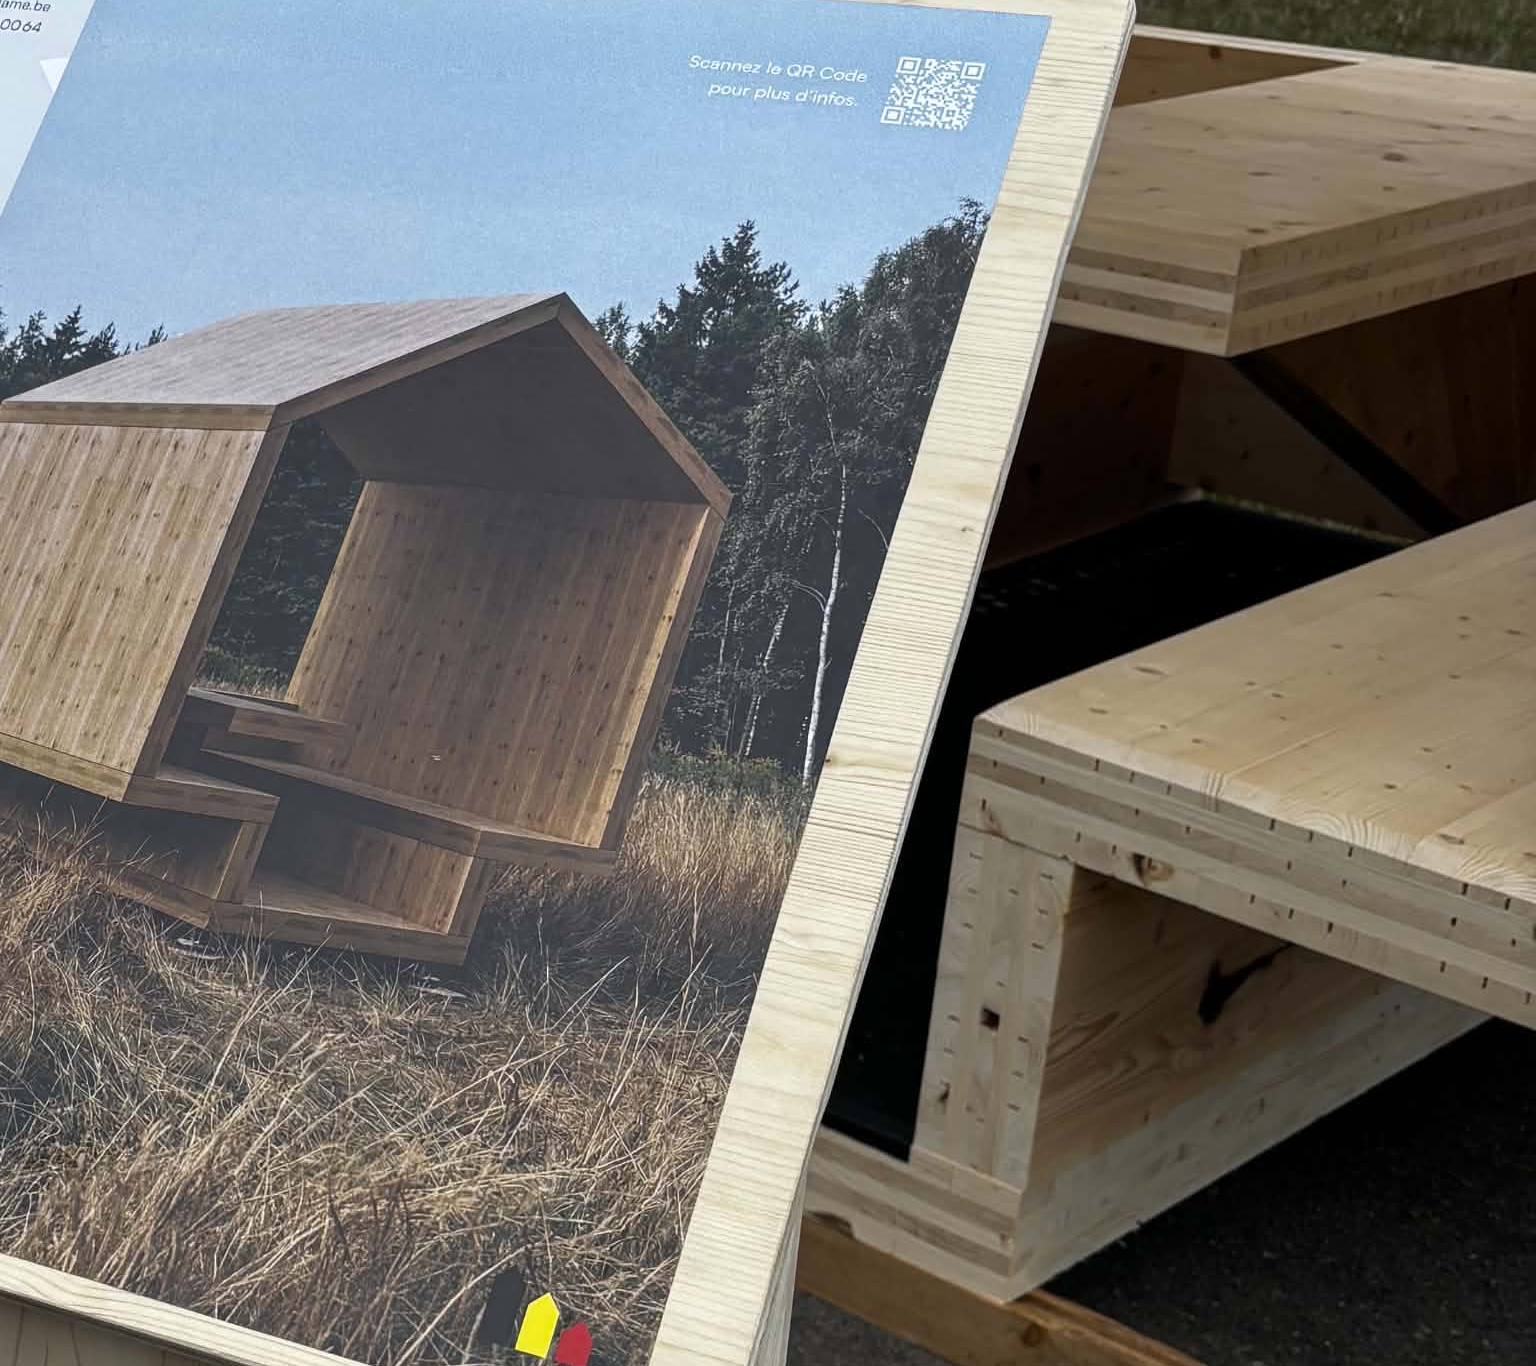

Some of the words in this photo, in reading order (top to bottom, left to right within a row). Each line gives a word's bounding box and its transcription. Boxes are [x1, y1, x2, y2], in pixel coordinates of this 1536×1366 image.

[688, 55, 761, 76] Scannez
[766, 62, 782, 77] le
[787, 64, 816, 79] QR
[820, 67, 868, 84] Code
[708, 83, 752, 98] pour
[754, 85, 790, 102] plus
